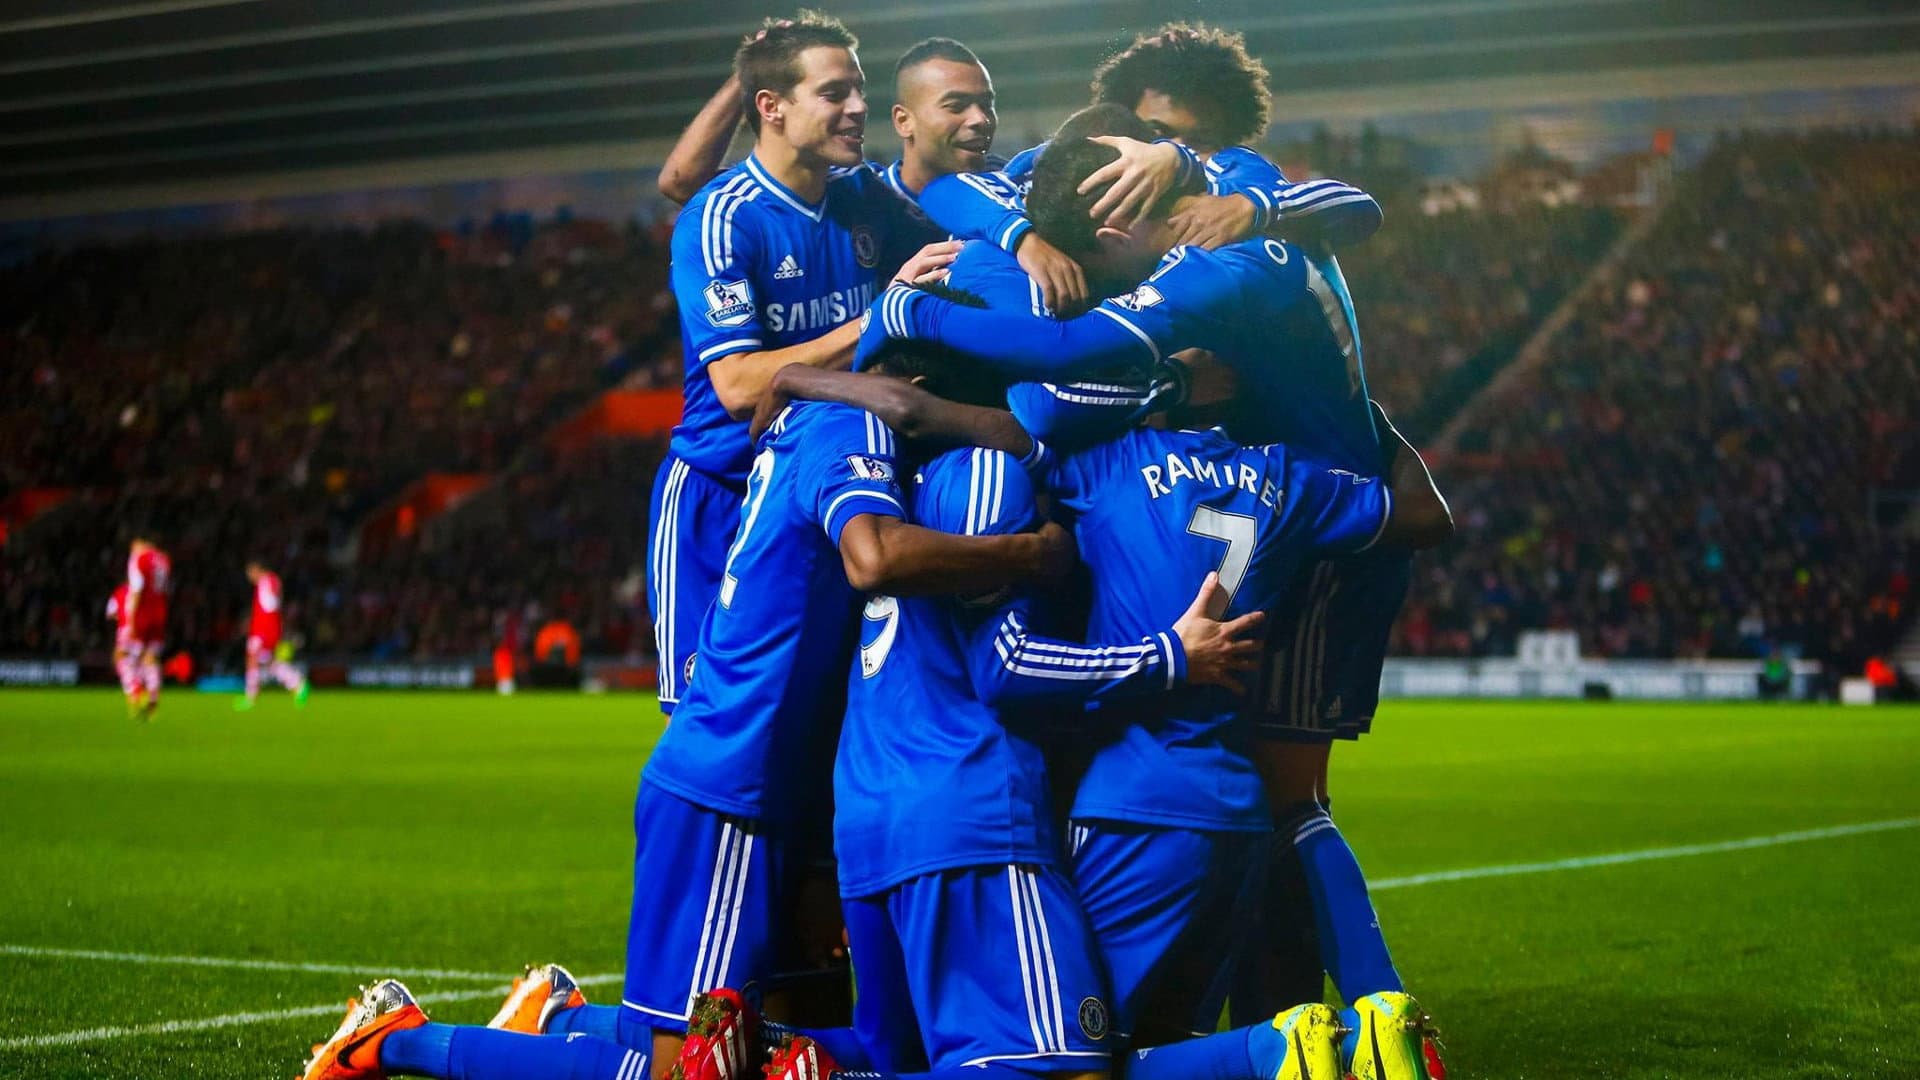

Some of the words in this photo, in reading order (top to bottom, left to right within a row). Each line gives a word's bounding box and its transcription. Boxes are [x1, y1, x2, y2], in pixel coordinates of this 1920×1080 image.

[774, 269, 804, 280] adidas
[766, 281, 873, 332] SAMSUN
[1141, 453, 1285, 516] RAMIRES
[1186, 504, 1258, 621] 7
